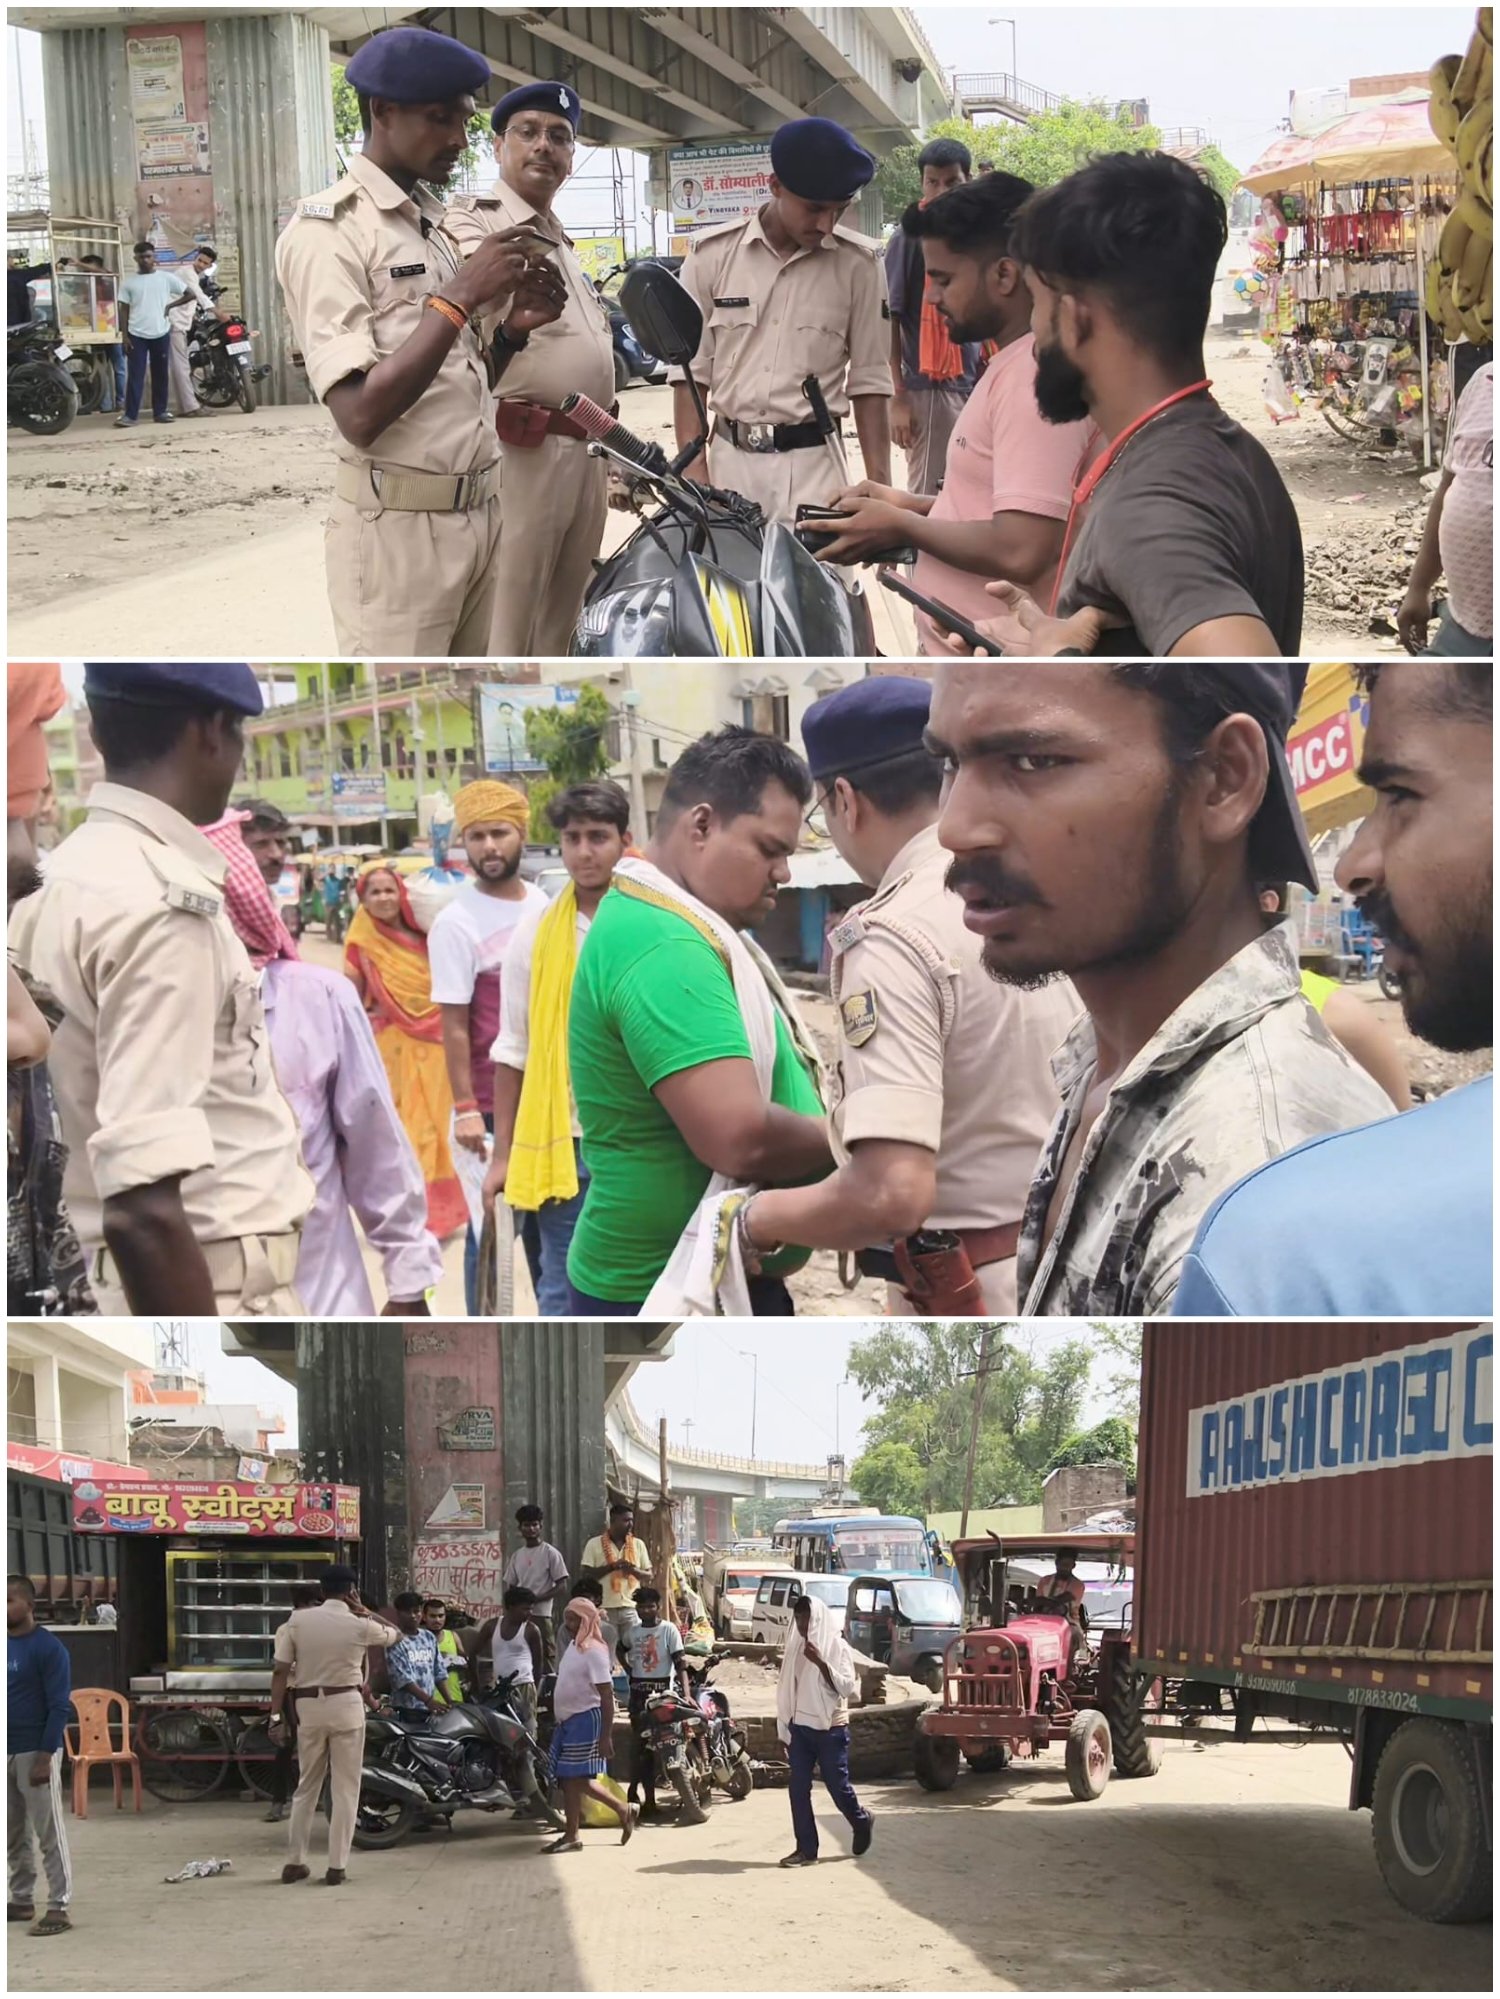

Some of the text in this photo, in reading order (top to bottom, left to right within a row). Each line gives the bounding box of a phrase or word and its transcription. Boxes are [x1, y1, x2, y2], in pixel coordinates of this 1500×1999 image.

[104, 1493, 178, 1530] बाबू
[181, 1484, 296, 1532] स्वीट्स
[415, 1557, 501, 1596] नशा मुक्ति
